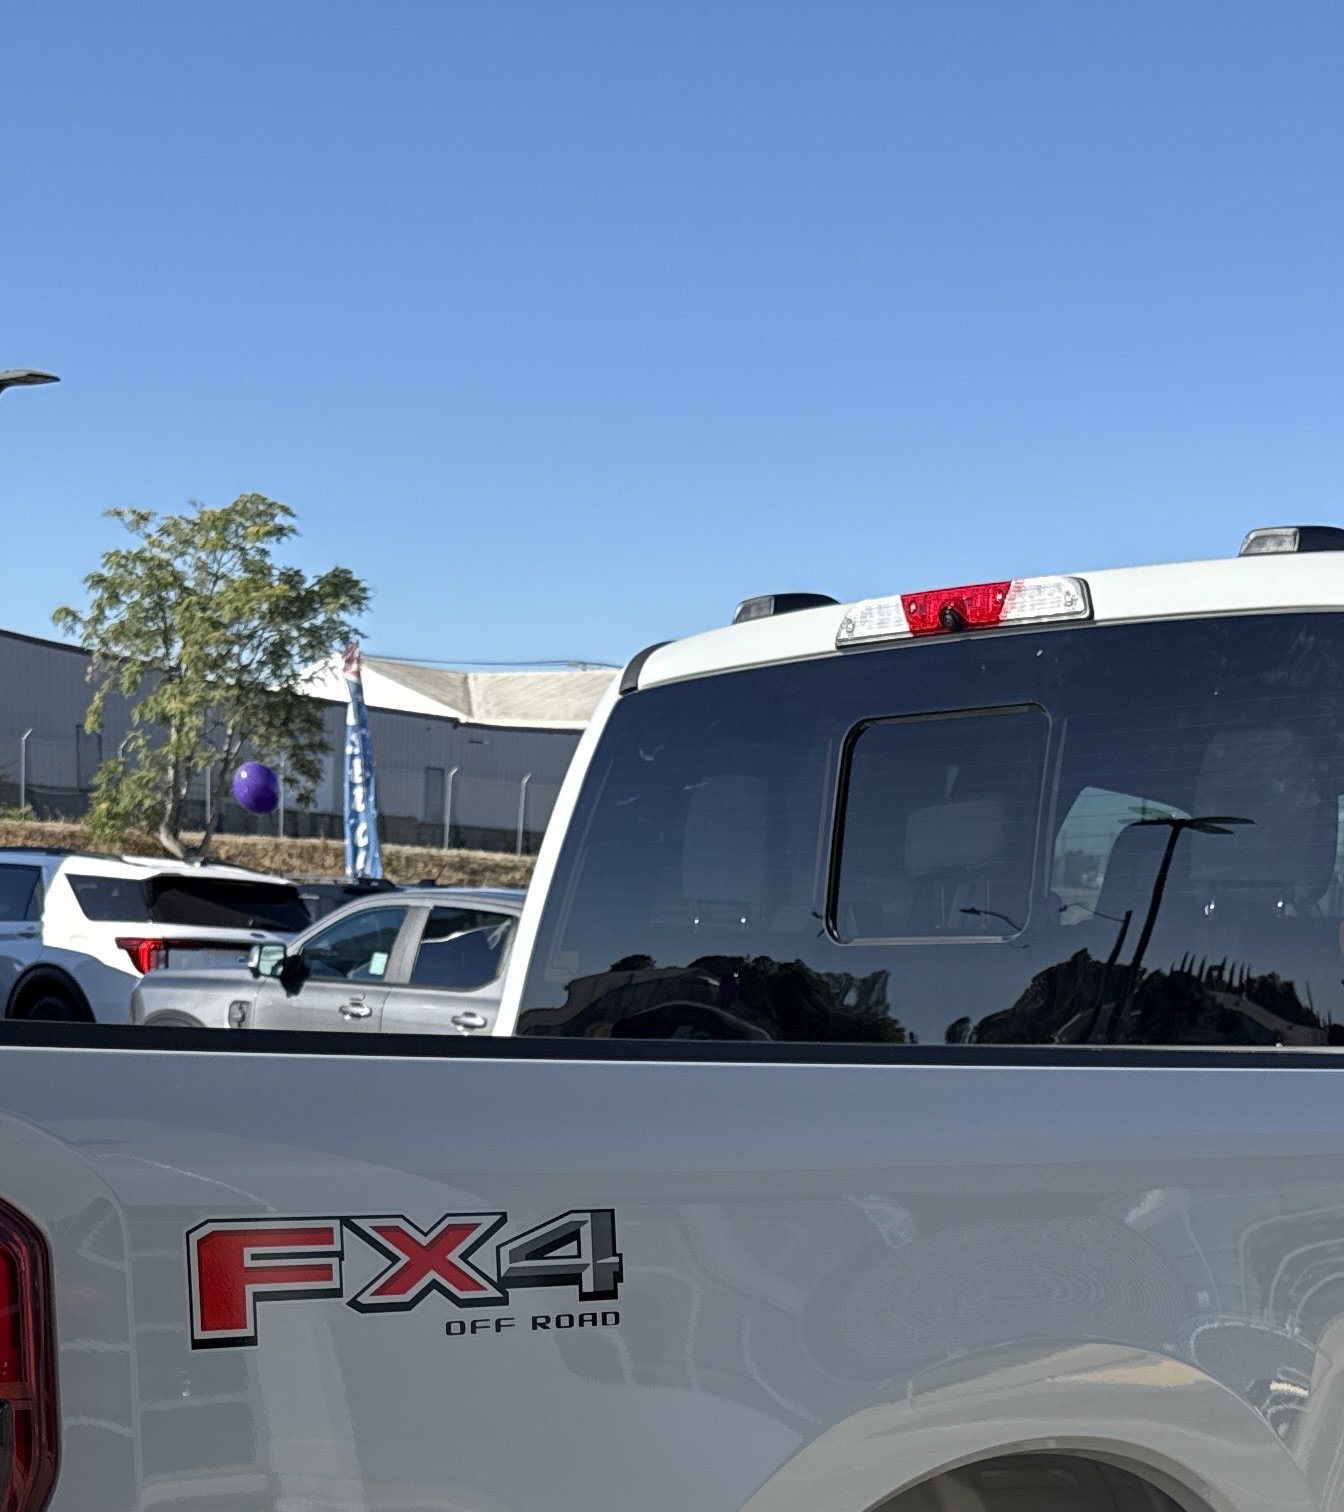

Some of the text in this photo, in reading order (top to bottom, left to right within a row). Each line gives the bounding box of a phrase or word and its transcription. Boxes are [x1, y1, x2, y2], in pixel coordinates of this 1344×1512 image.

[185, 1208, 623, 1350] FX4
[445, 1310, 620, 1336] OFF ROAD
